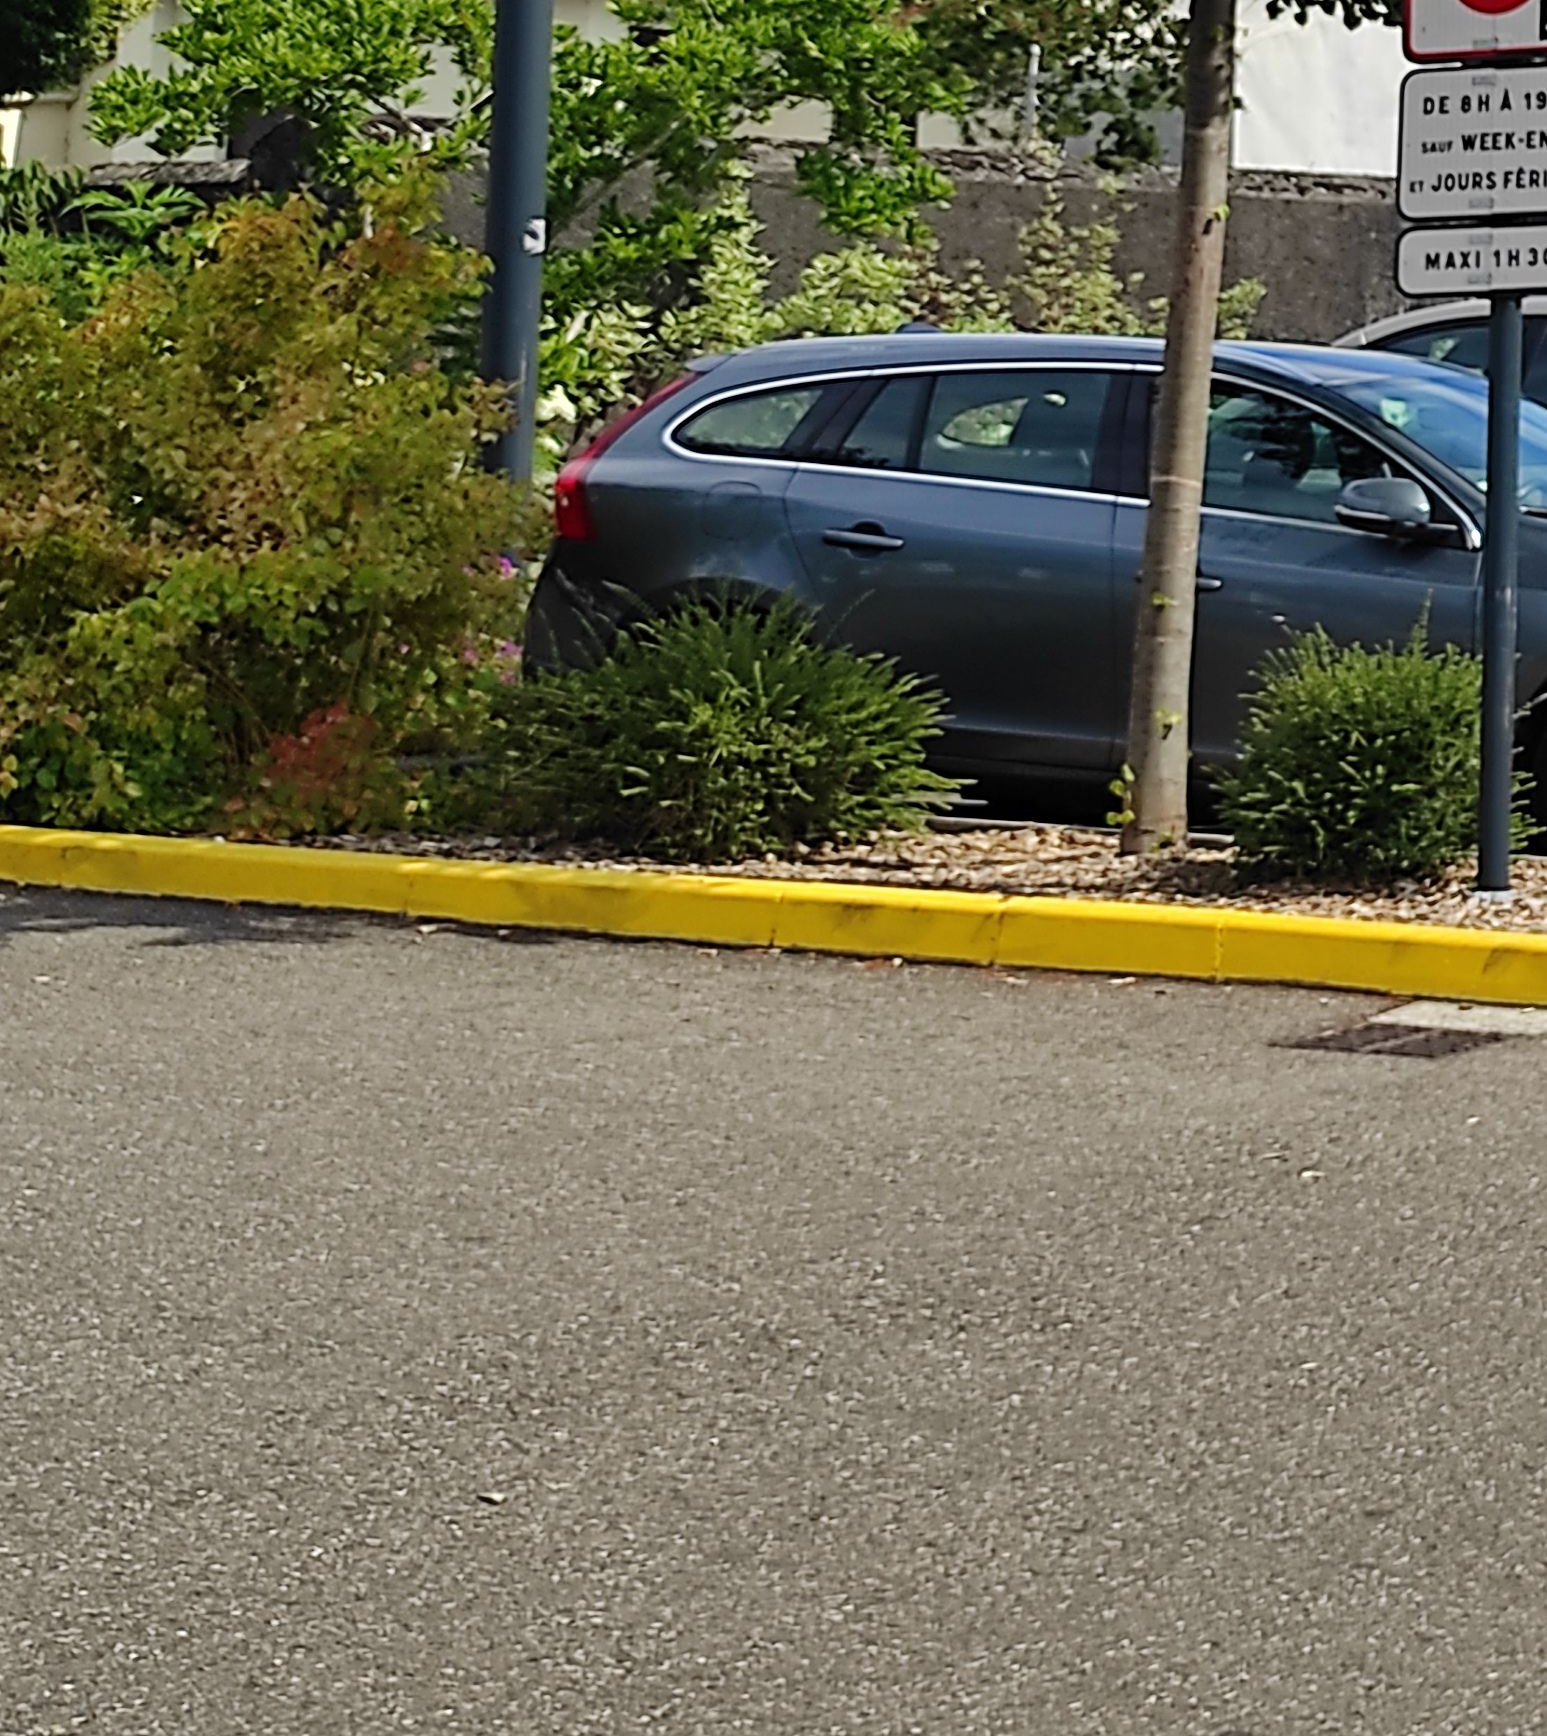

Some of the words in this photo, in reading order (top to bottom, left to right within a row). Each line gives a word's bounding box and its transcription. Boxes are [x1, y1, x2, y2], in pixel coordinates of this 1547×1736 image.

[1423, 96, 1450, 115] DE
[1421, 140, 1454, 154] SAUF
[1409, 180, 1425, 193] ET
[1431, 171, 1497, 192] JOURS
[1425, 250, 1481, 271] MAXI
